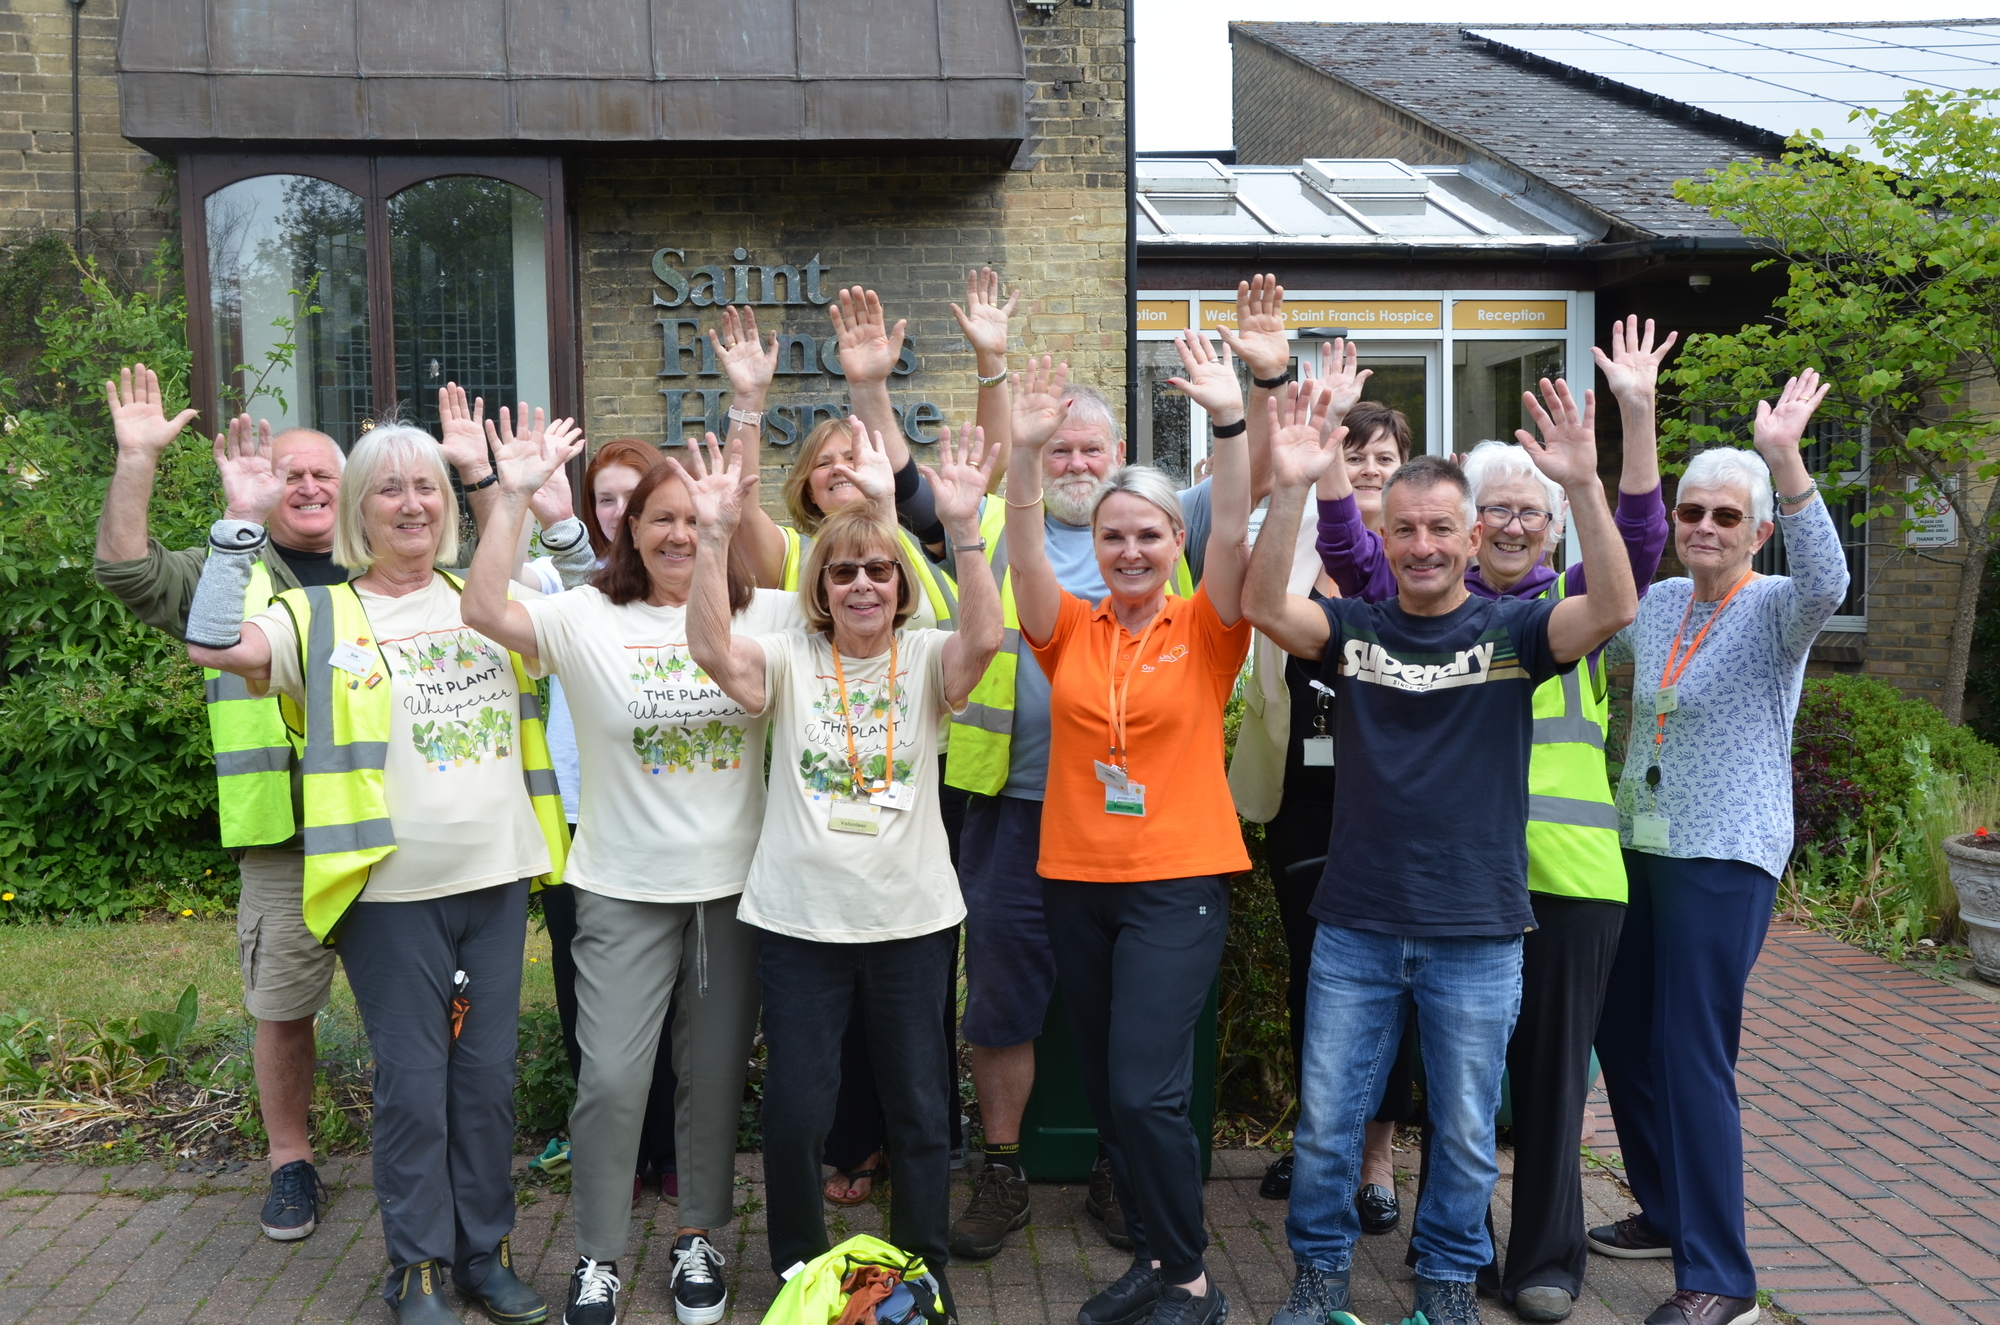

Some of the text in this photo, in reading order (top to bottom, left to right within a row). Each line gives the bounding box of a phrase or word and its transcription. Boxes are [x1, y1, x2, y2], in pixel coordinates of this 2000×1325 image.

[652, 247, 832, 307] Saint
[1205, 309, 1238, 321] Welc
[1292, 309, 1325, 322] Saint
[1328, 309, 1376, 322] Francis
[1379, 309, 1434, 324] Hospice
[1477, 309, 1546, 324] Reception
[655, 318, 917, 375] Frncs
[415, 668, 497, 695] THE PLANT
[1393, 680, 1413, 690] SINCE
[643, 688, 729, 701] THE PLAN
[404, 689, 512, 718] Whisperer
[628, 700, 746, 725] Whisperer
[821, 720, 848, 737] THE
[840, 820, 867, 829] Volunteer
